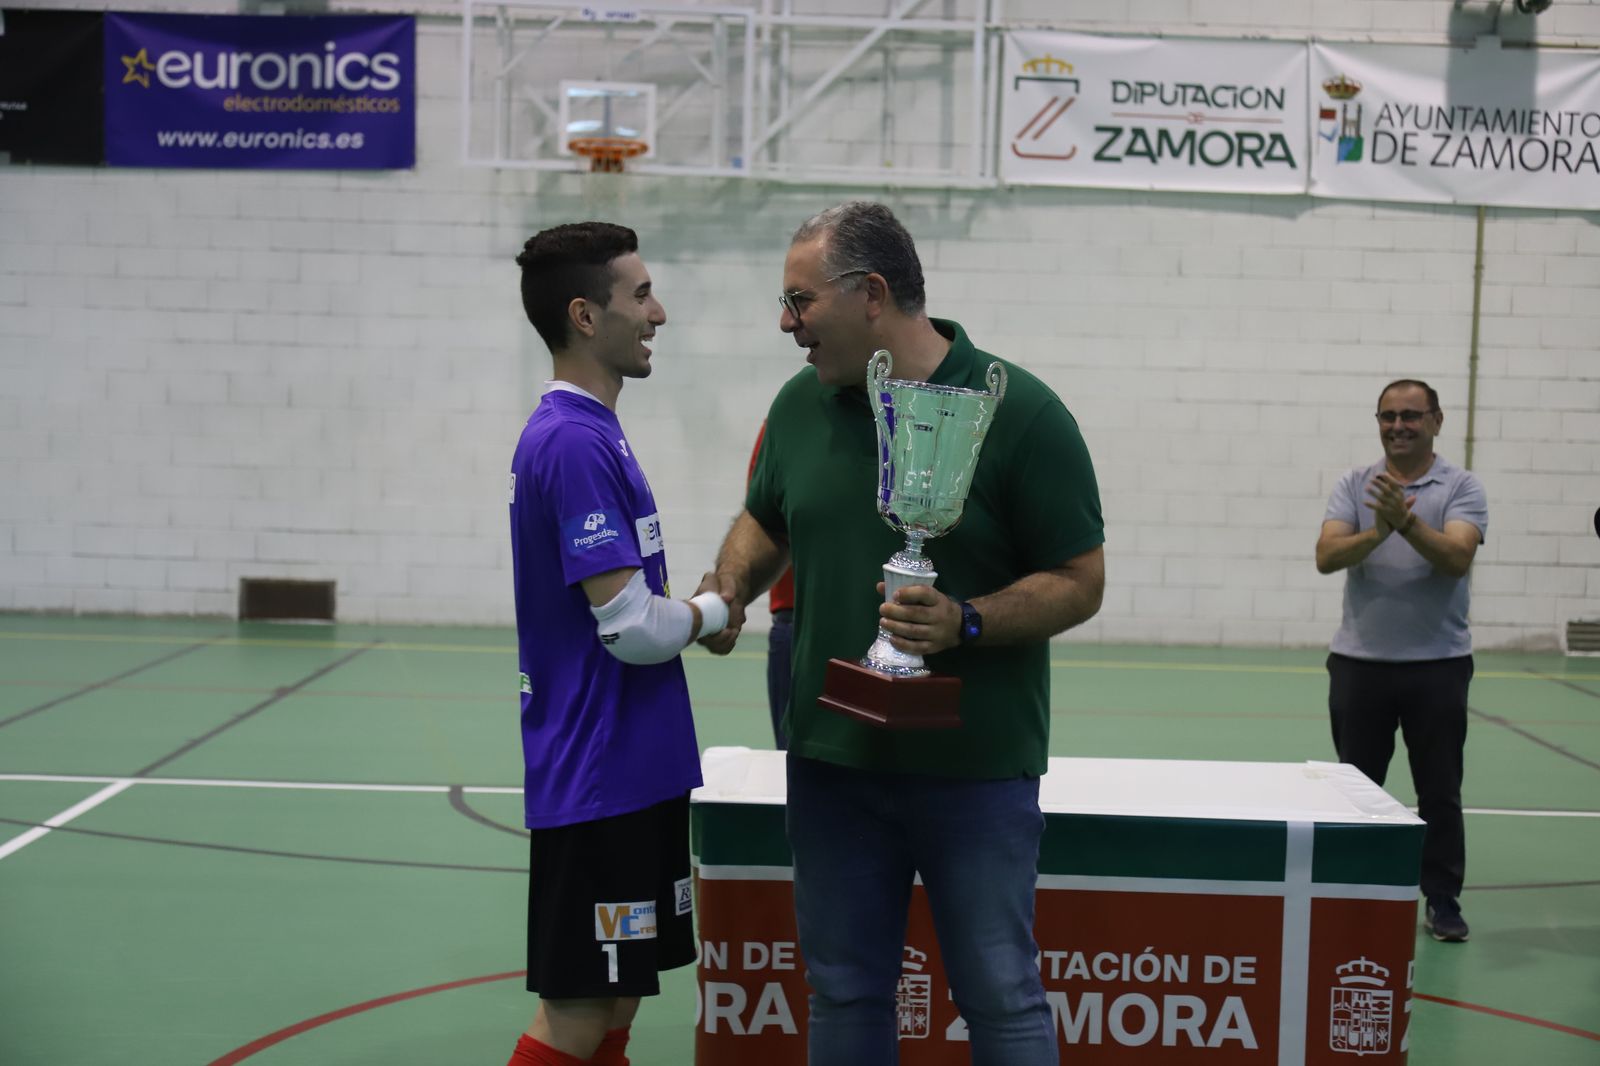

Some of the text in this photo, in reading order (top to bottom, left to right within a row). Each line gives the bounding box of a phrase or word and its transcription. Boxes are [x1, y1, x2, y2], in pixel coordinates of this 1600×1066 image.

[156, 41, 400, 90] euronics
[157, 129, 364, 149] www.euronics.es
[1374, 103, 1600, 139] AYUNTAMIENTO
[1093, 125, 1297, 169] ZAMORA
[1371, 131, 1600, 174] DE ZAMORA
[601, 943, 619, 983] 1
[697, 940, 796, 970] N DE
[1203, 954, 1257, 985] DE
[695, 980, 799, 1035] RA
